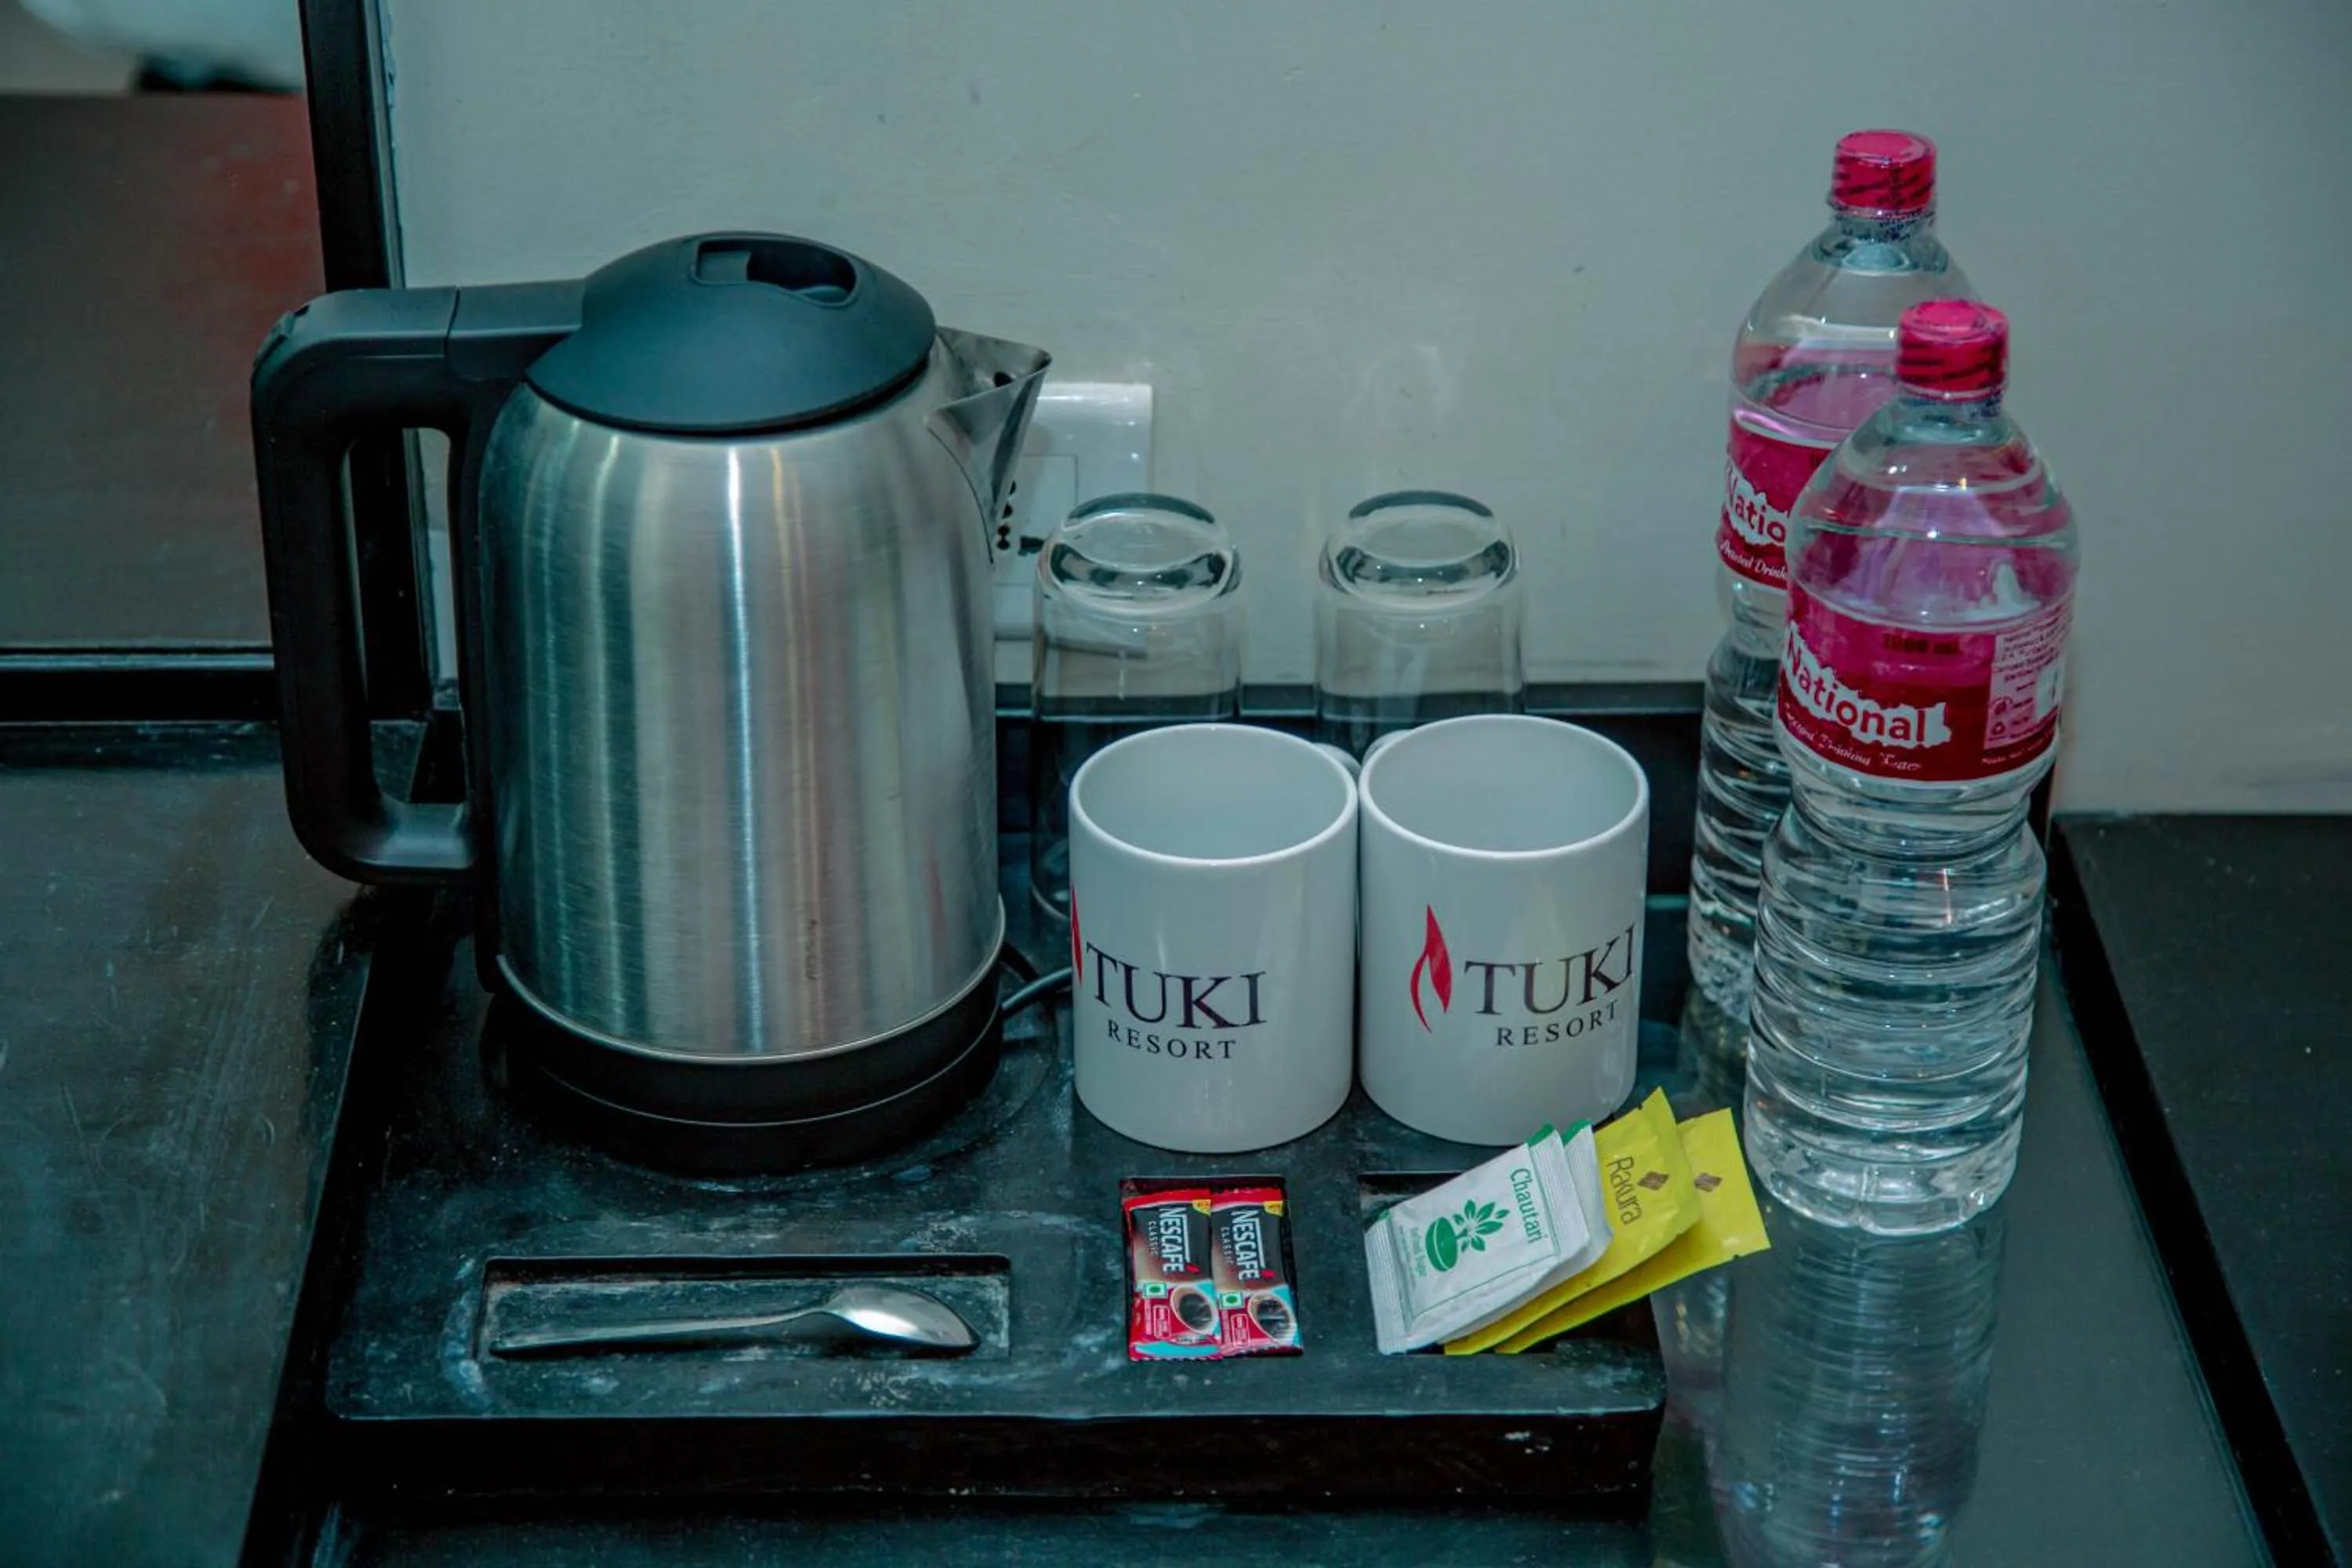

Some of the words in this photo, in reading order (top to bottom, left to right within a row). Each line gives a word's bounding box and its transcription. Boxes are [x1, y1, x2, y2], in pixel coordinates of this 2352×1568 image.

[1726, 463, 1786, 542] Natio
[1786, 635, 1927, 743] National
[1086, 941, 1268, 1030] TUKI
[1464, 921, 1635, 1016] TUKI
[1106, 1018, 1236, 1061] RESORT
[1496, 997, 1620, 1047] RESORT
[1510, 1167, 1547, 1244] Chautari
[1606, 1156, 1643, 1227] Rakura
